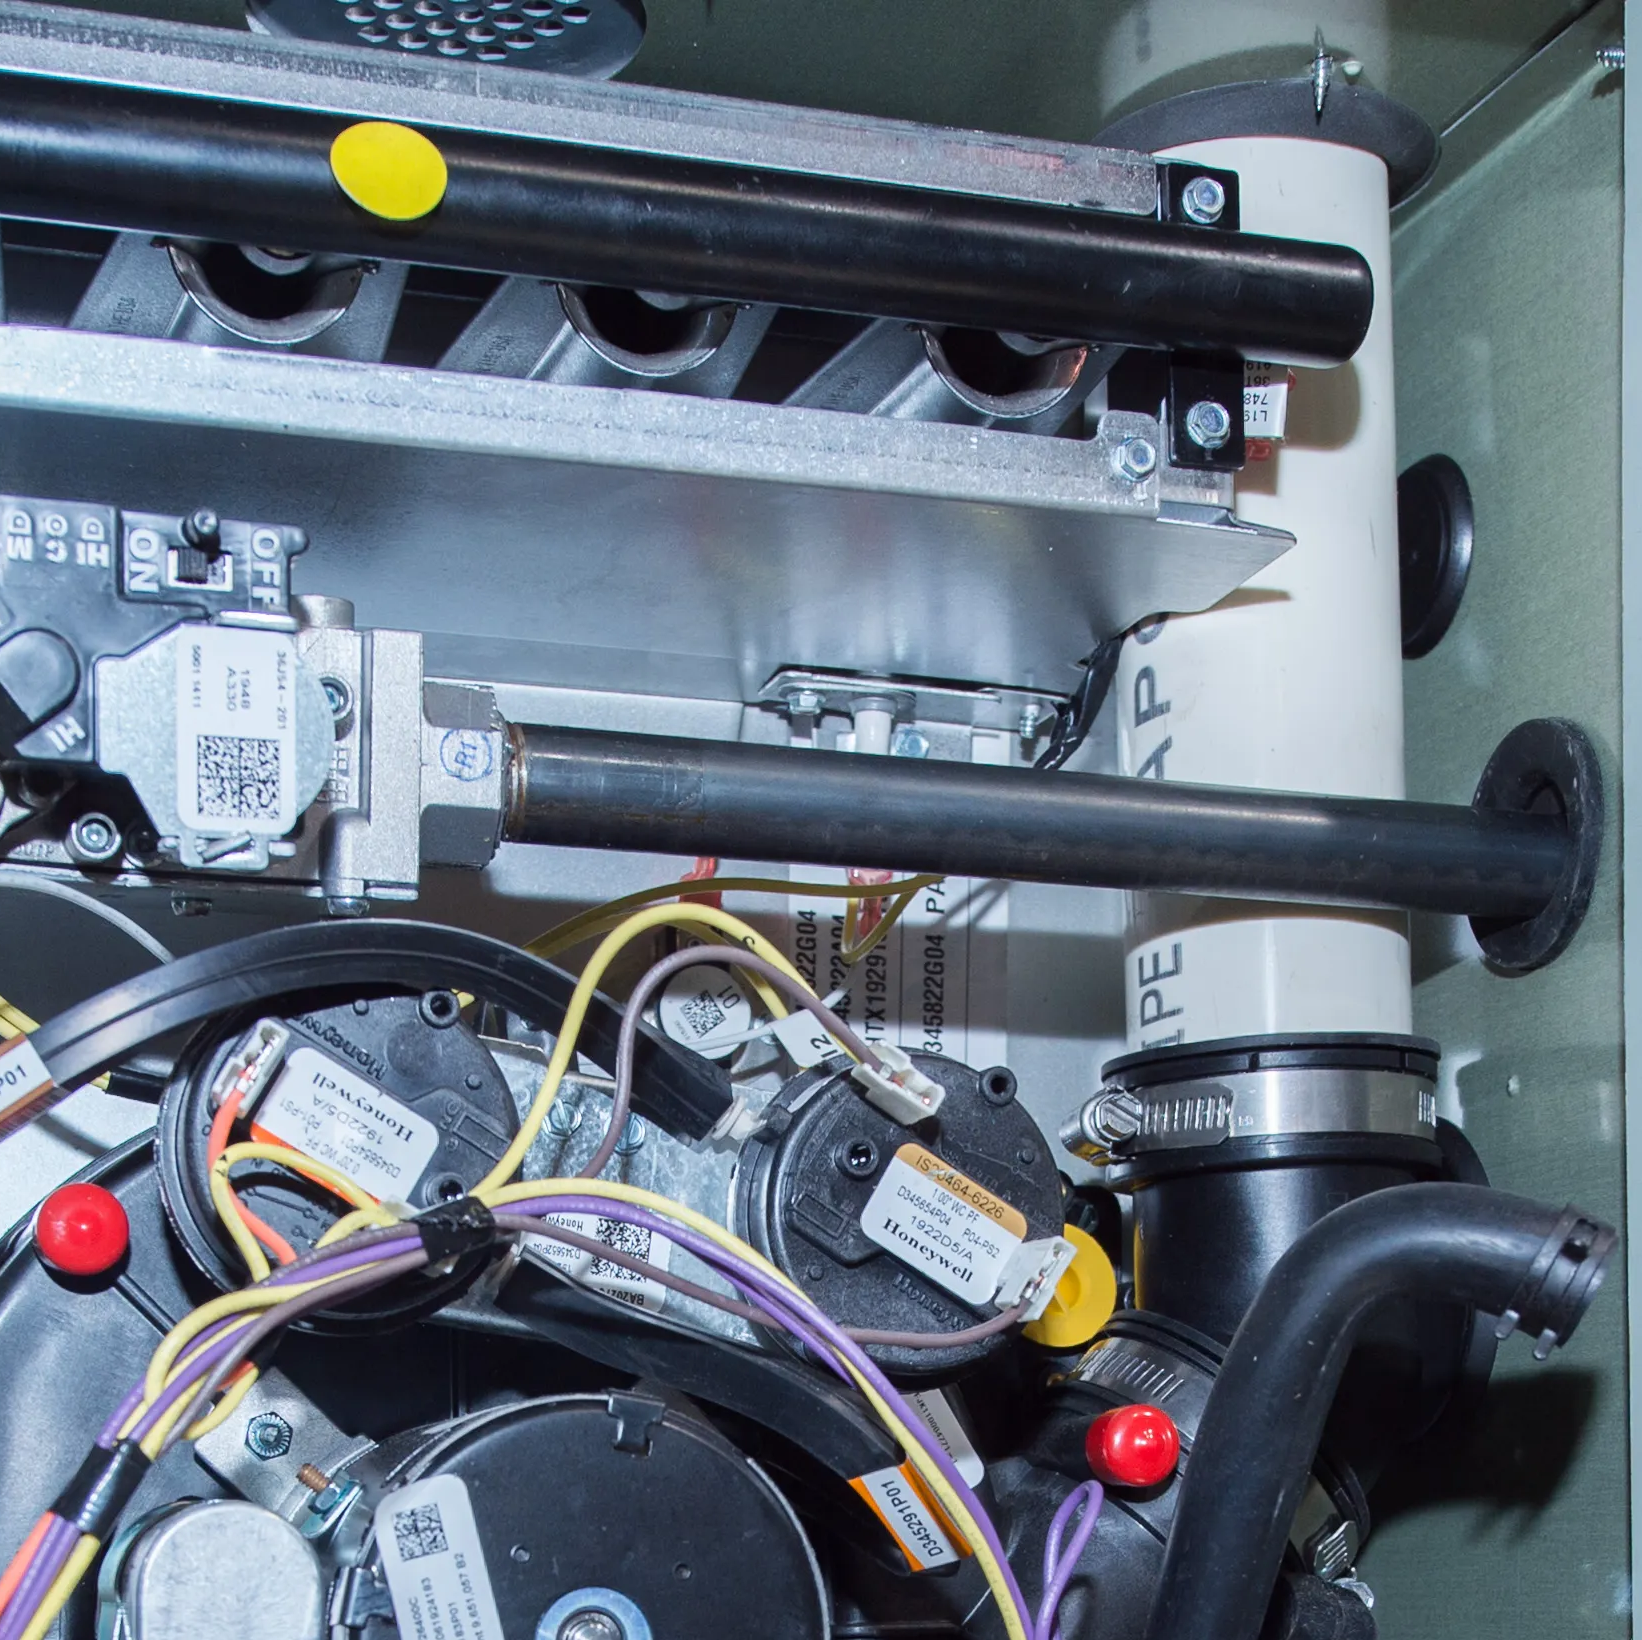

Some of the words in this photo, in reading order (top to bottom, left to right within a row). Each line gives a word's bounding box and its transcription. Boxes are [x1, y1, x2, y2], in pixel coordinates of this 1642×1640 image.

[128, 527, 159, 593] ON
[250, 528, 282, 606] OFF
[45, 714, 86, 752] HI
[311, 1071, 415, 1144] Honeywell
[882, 1216, 974, 1284] Honeywell
[910, 1215, 974, 1264] 1922D5/A
[880, 1479, 945, 1558] D345291P01
